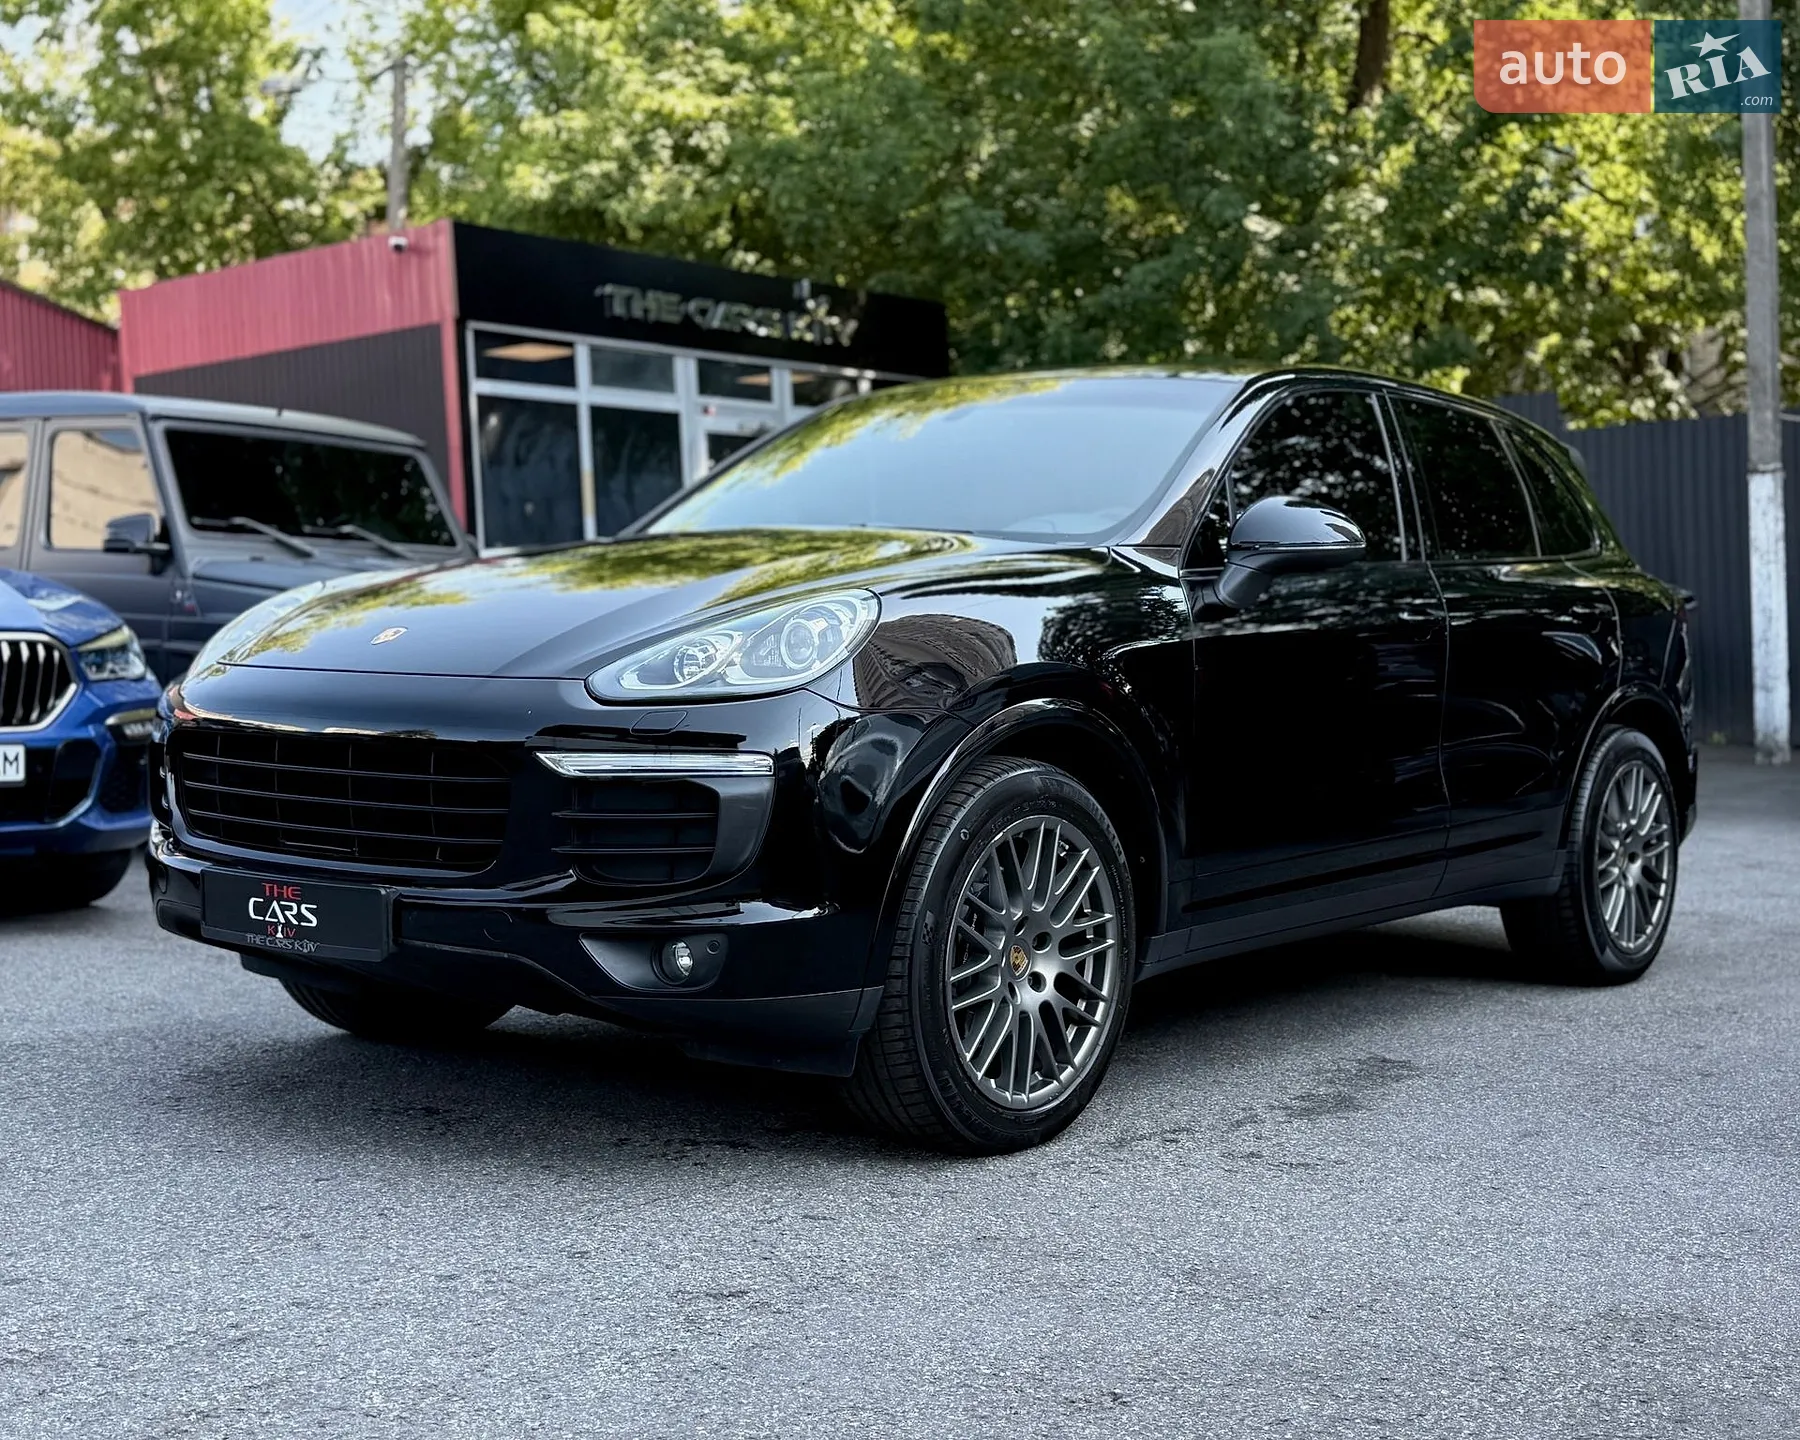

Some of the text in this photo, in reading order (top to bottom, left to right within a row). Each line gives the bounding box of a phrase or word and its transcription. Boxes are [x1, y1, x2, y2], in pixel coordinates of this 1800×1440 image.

[596, 282, 684, 325] THE
[262, 882, 302, 900] THE
[248, 897, 318, 928] CARS
